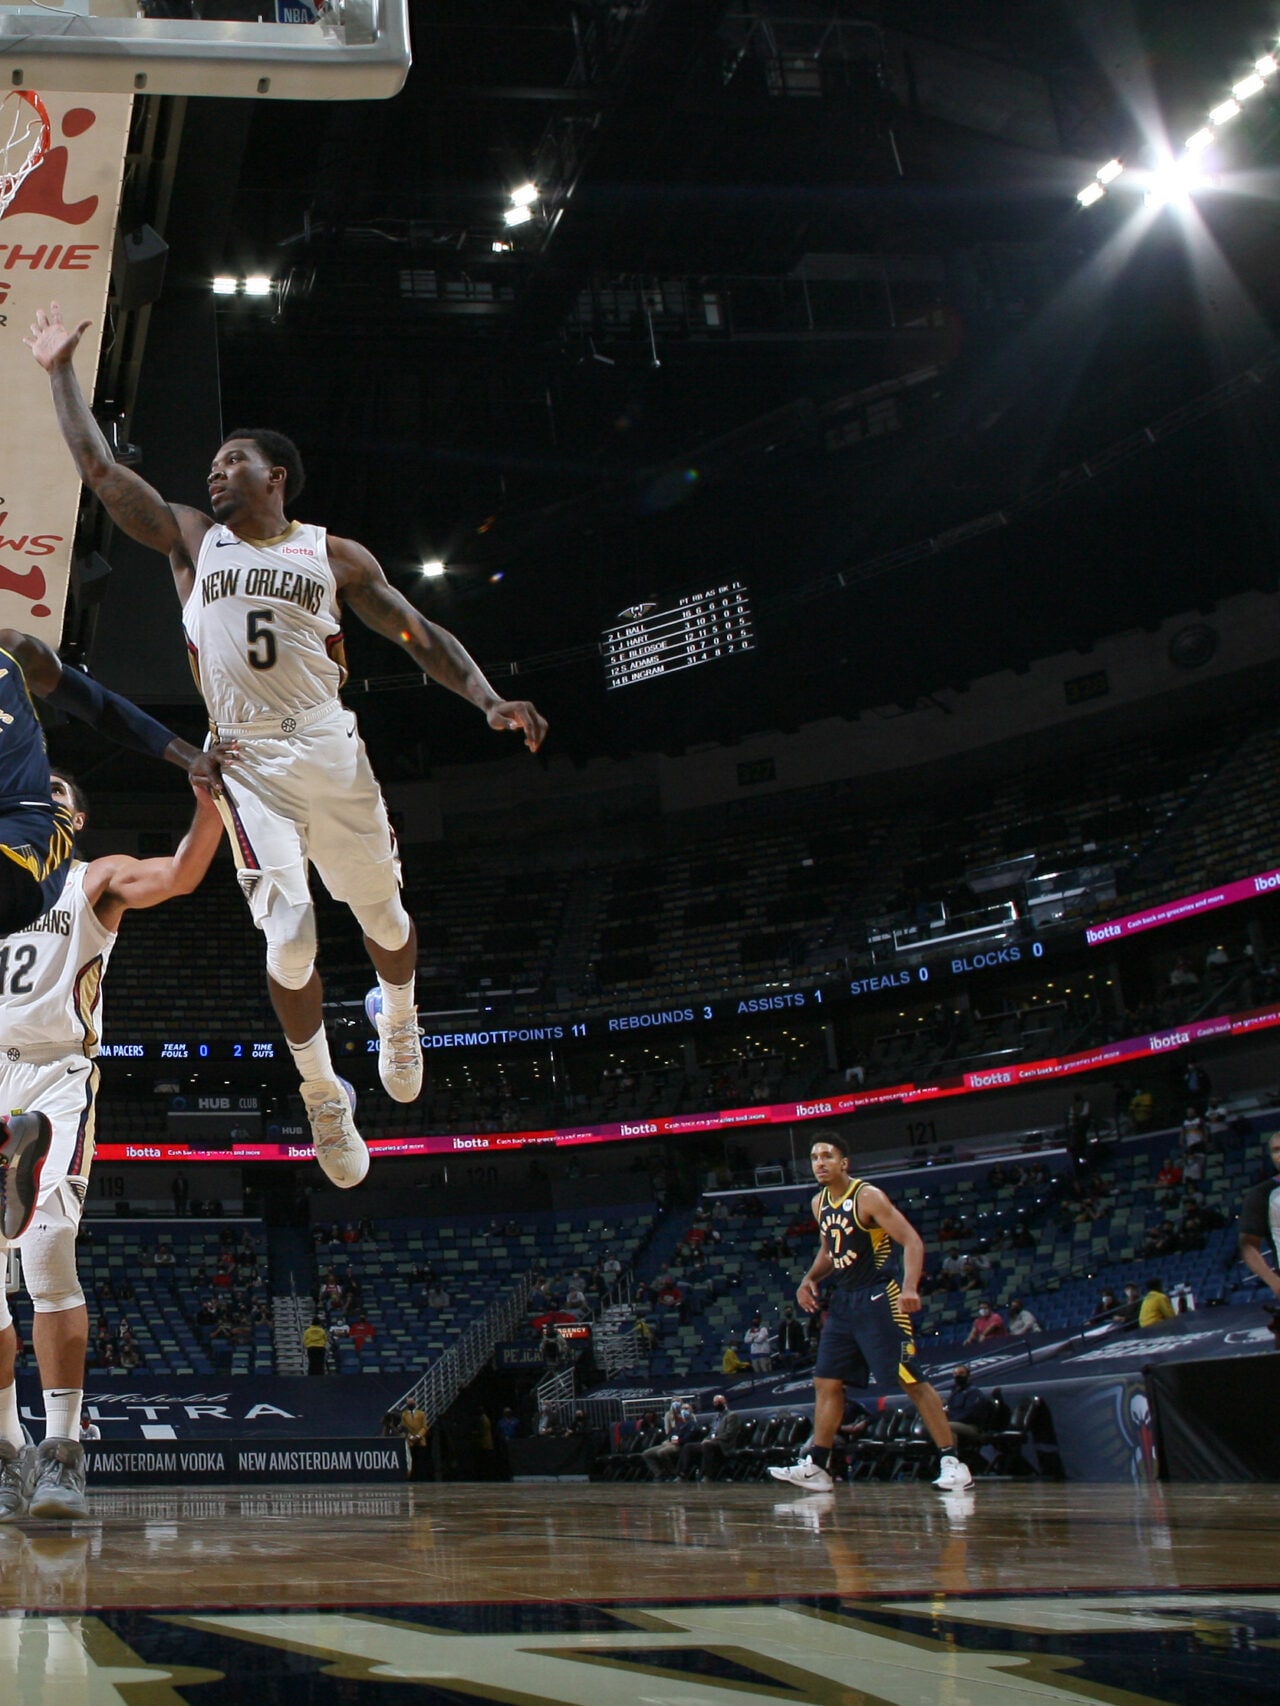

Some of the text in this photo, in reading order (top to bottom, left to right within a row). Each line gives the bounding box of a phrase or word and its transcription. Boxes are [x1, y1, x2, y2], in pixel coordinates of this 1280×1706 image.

[284, 8, 308, 23] NBA
[282, 546, 314, 556] ibotta
[201, 568, 325, 615] NEW ORLEANS
[247, 609, 277, 671] 5
[1086, 923, 1122, 943] ibotta
[951, 942, 1044, 974] BLOCKS 0
[850, 967, 929, 995] STEALS 0
[737, 989, 823, 1014] ASSISTS 1
[609, 1006, 713, 1031] REBOUNDS 3
[571, 1023, 587, 1037] 11
[1150, 1032, 1190, 1050] ibotta
[113, 1045, 144, 1057] PACERS
[161, 1050, 189, 1058] FOULS
[200, 1045, 242, 1057] 0 2
[970, 1073, 1011, 1088] ibotta
[198, 1097, 258, 1109] HUB CLUB
[796, 1103, 832, 1116] ibotta
[282, 1126, 303, 1135] HUB
[620, 1123, 657, 1136] ibotta
[906, 1121, 937, 1145] 121
[453, 1138, 489, 1148] ibotta
[126, 1147, 161, 1156] ibotta
[830, 1228, 841, 1253] 7
[93, 1453, 177, 1472] AMSTERDAM
[180, 1453, 225, 1471] VODKA
[239, 1451, 399, 1471] NEW AMSTERDAM VODKA
